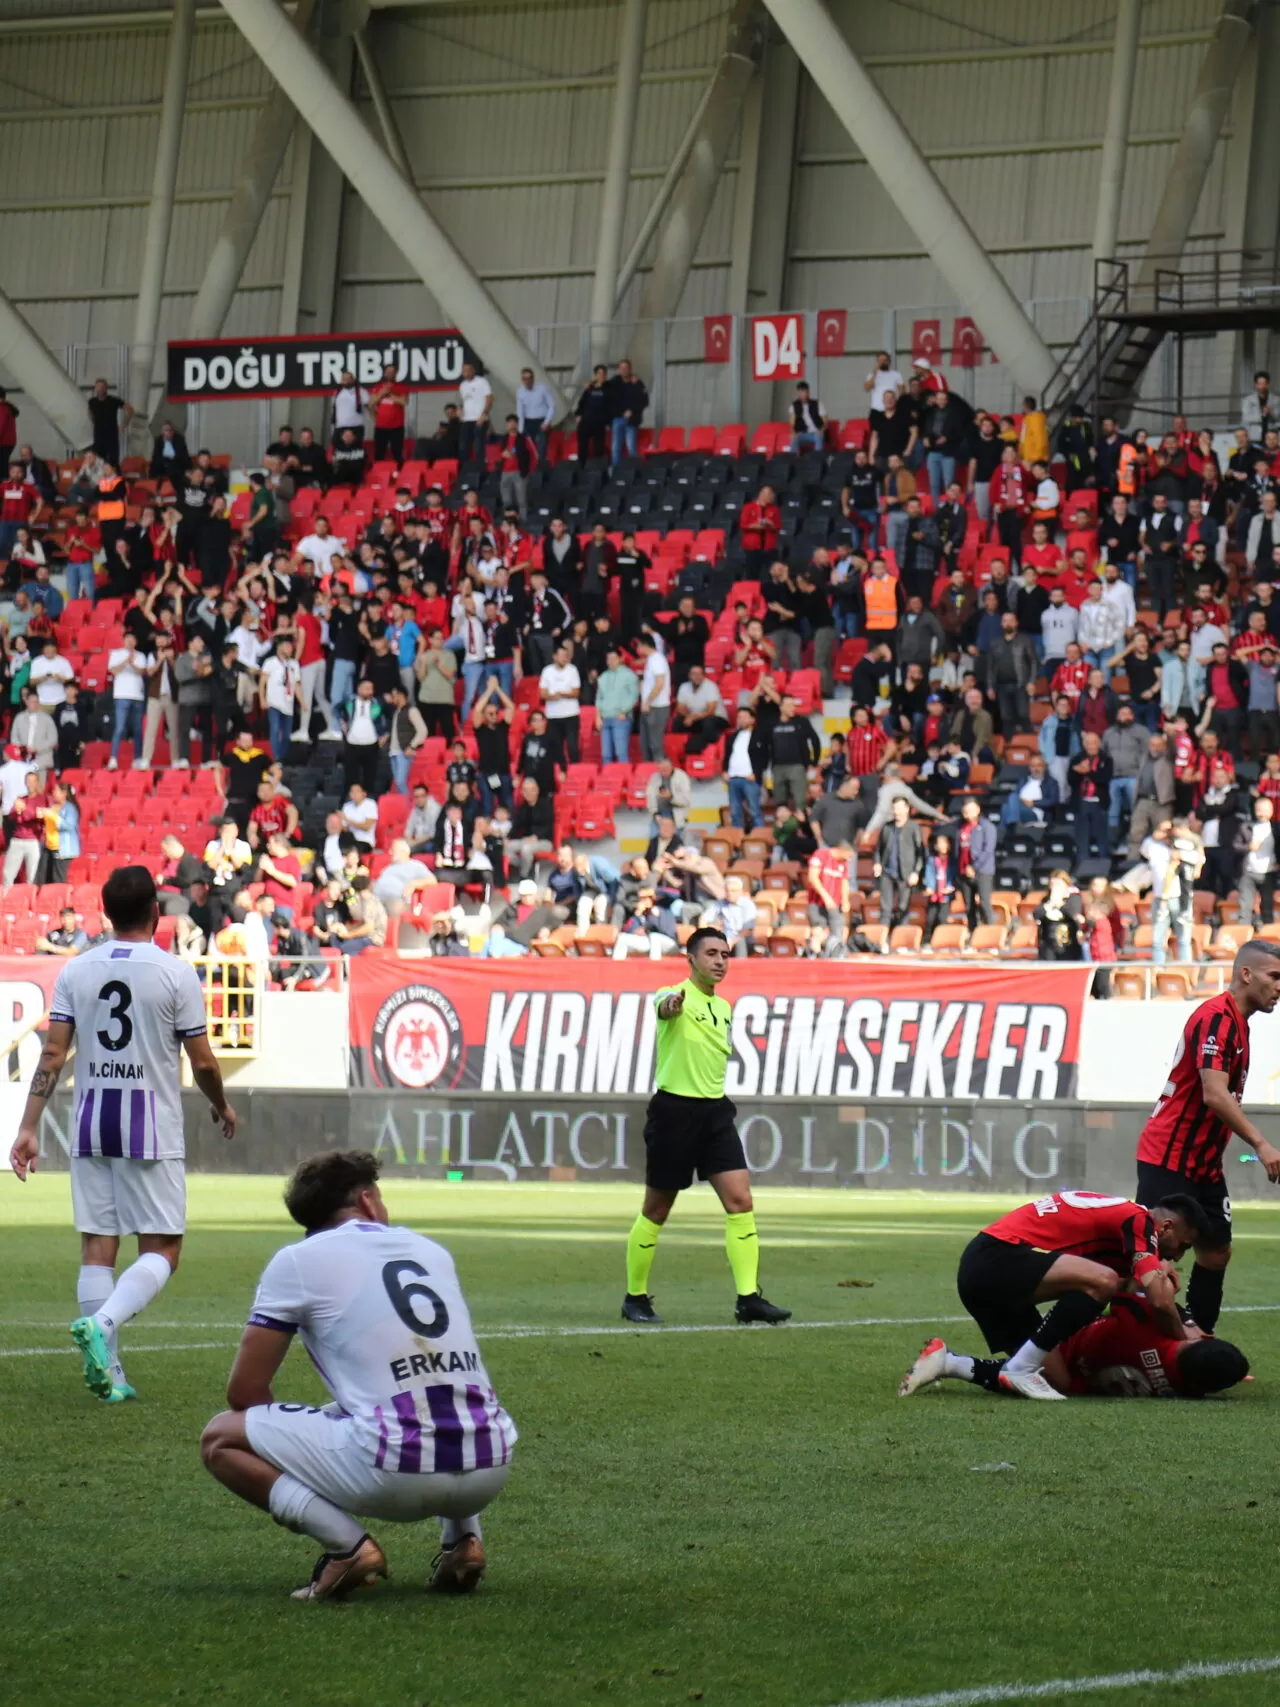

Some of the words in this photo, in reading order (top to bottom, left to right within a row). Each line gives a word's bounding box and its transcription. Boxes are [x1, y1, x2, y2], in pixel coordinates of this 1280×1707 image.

[184, 347, 286, 391] DOĞU
[297, 339, 465, 385] TRİBÜNÜ
[753, 318, 801, 376] D4
[97, 980, 133, 1051] 3
[382, 1260, 450, 1339] 6
[390, 1351, 480, 1382] ERKAM
